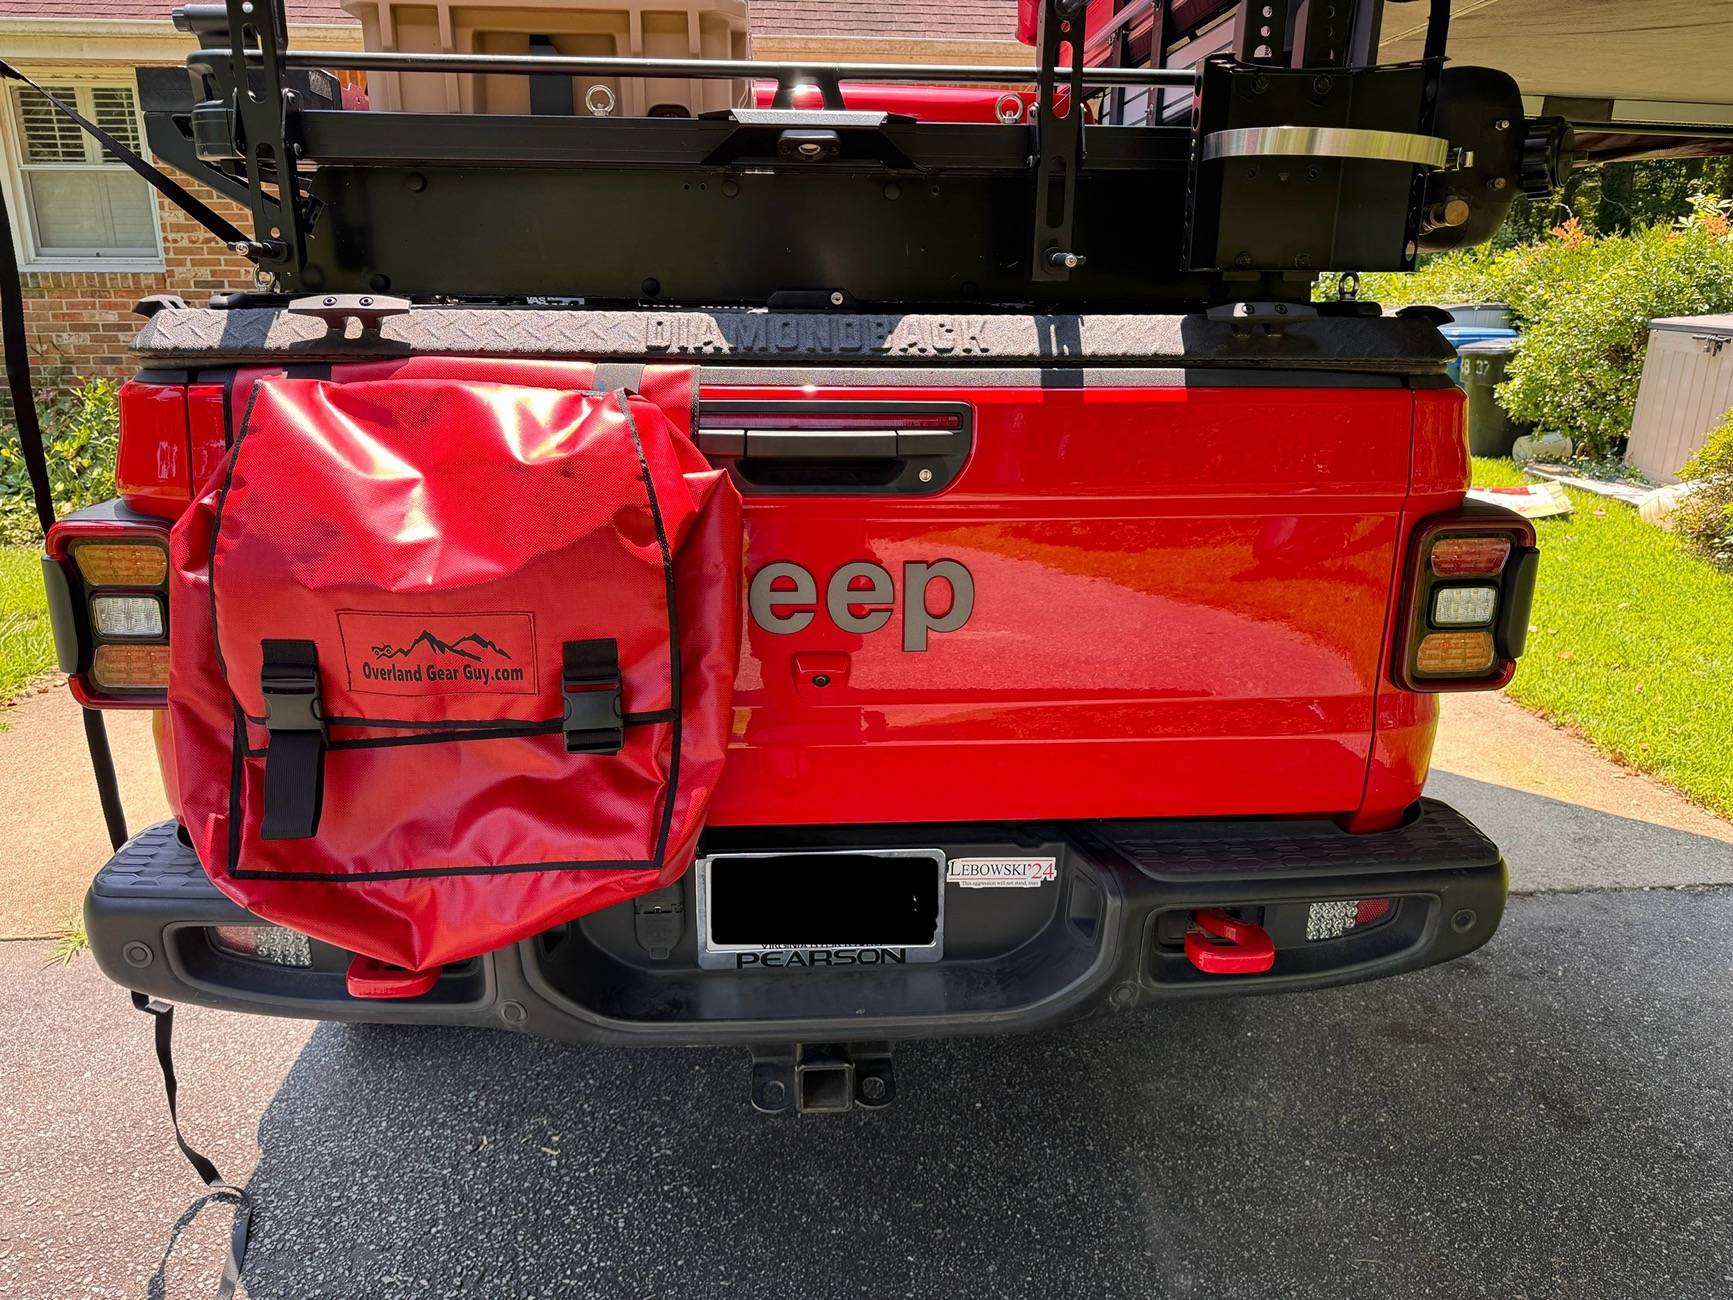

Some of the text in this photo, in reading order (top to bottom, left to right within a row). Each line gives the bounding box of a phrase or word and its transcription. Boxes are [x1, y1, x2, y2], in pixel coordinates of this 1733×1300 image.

[646, 312, 989, 353] DIAMONDBACK
[748, 559, 975, 652] eep
[362, 661, 524, 686] Overland Gear Guy.com
[736, 948, 906, 970] PEARSON
